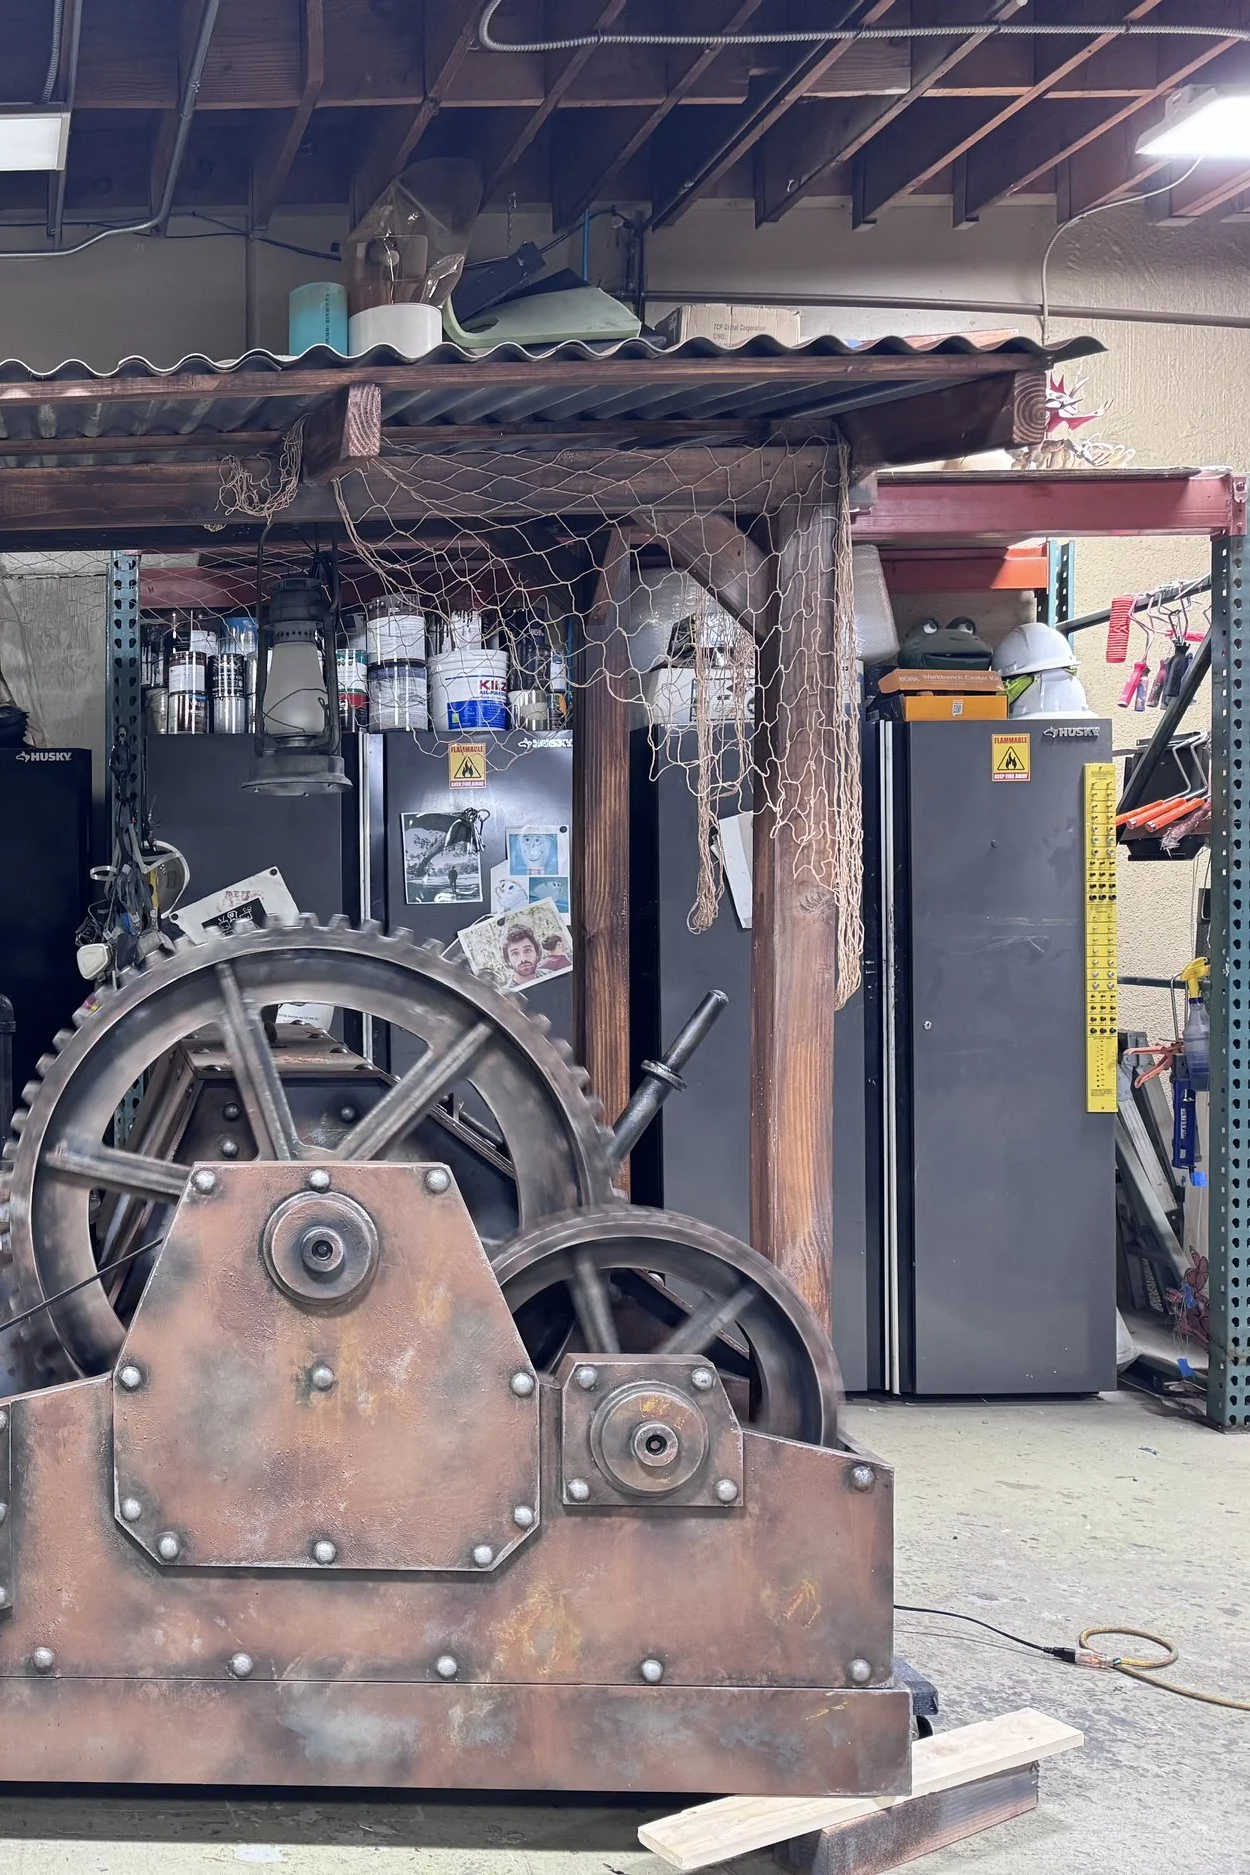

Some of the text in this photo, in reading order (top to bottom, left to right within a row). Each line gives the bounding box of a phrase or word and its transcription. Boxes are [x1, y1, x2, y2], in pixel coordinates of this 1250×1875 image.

[1058, 726, 1101, 738] HUSKY
[994, 736, 1028, 744] FLAMMABLE
[30, 751, 72, 762] HUSKY
